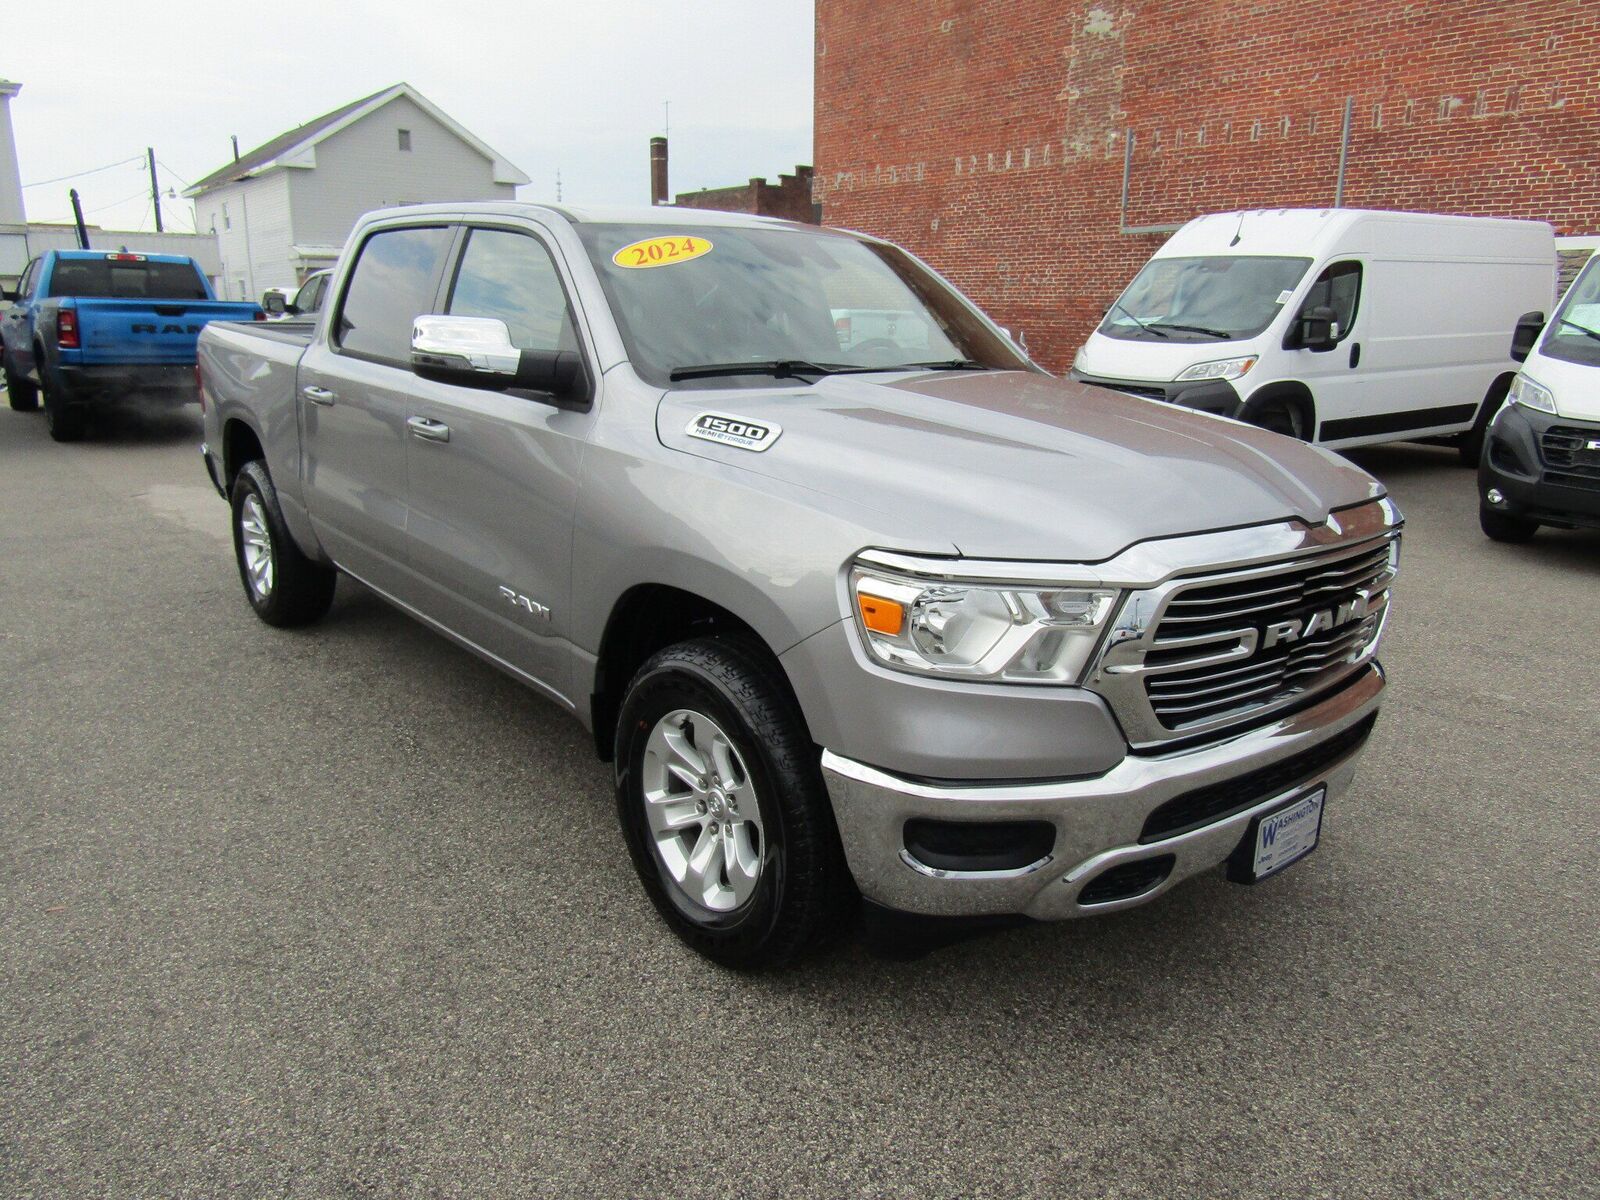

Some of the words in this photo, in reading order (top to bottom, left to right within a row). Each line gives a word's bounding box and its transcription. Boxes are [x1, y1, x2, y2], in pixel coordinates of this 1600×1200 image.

[632, 238, 695, 265] 2024
[695, 428, 717, 437] HEMI
[703, 417, 765, 440] 1500
[1263, 590, 1369, 650] RAM
